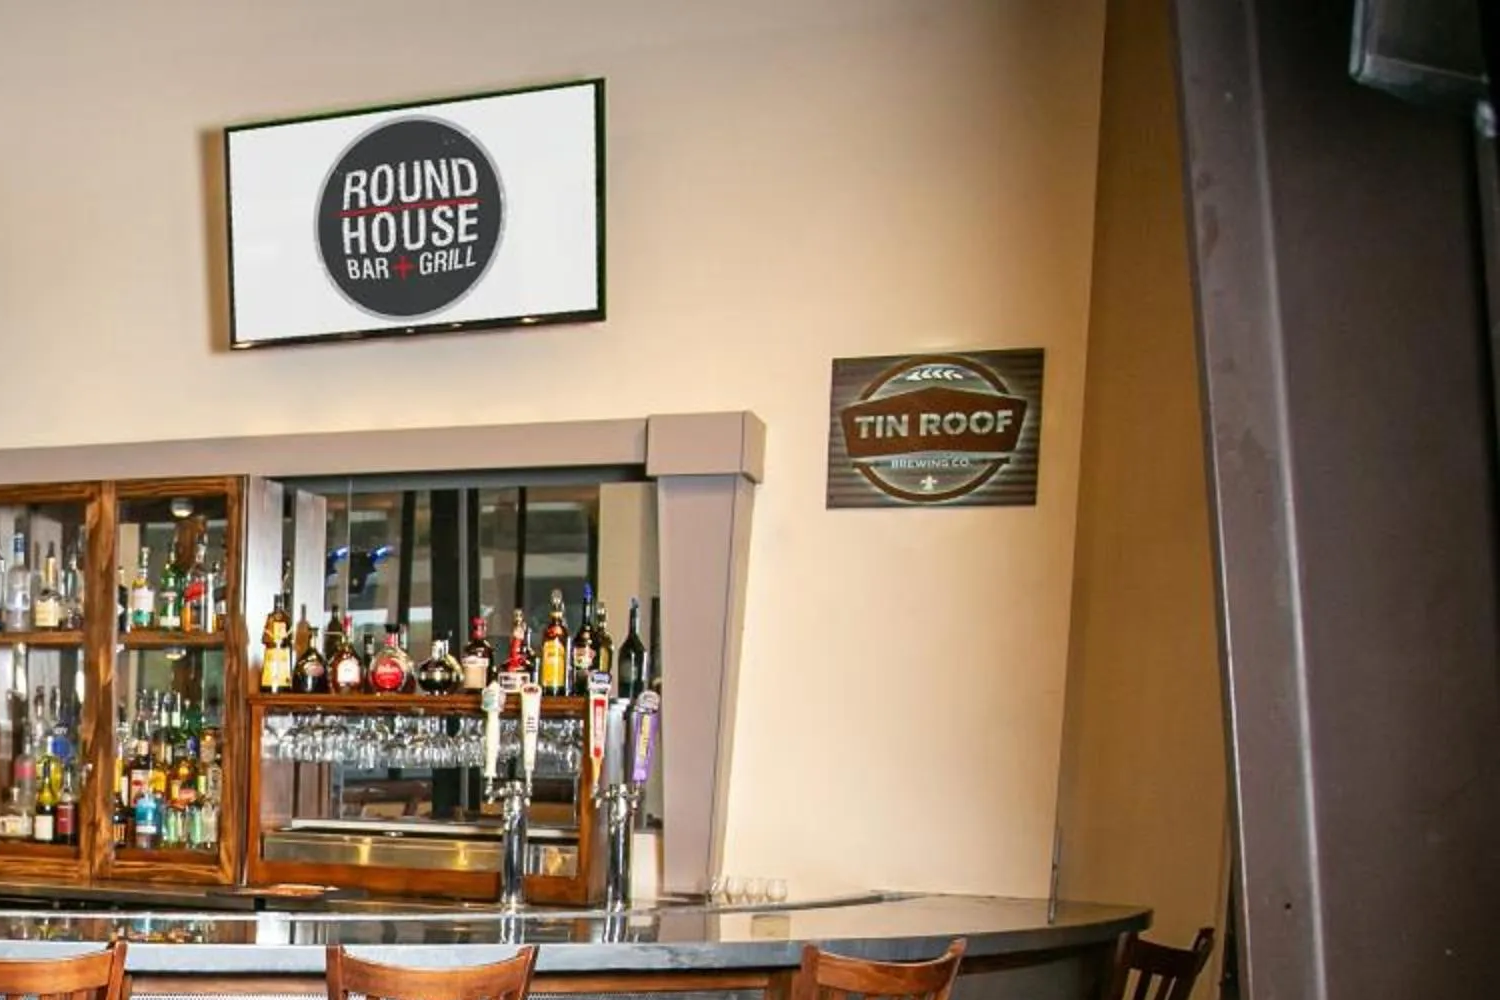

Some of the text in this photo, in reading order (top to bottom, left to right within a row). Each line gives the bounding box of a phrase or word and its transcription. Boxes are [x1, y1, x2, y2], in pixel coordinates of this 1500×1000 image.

[342, 157, 479, 211] ROUND
[342, 202, 479, 255] HOUSE
[346, 257, 390, 280] BAR
[419, 246, 477, 276] GRILL
[854, 410, 1013, 439] TIN ROOF
[891, 458, 949, 469] BREWING
